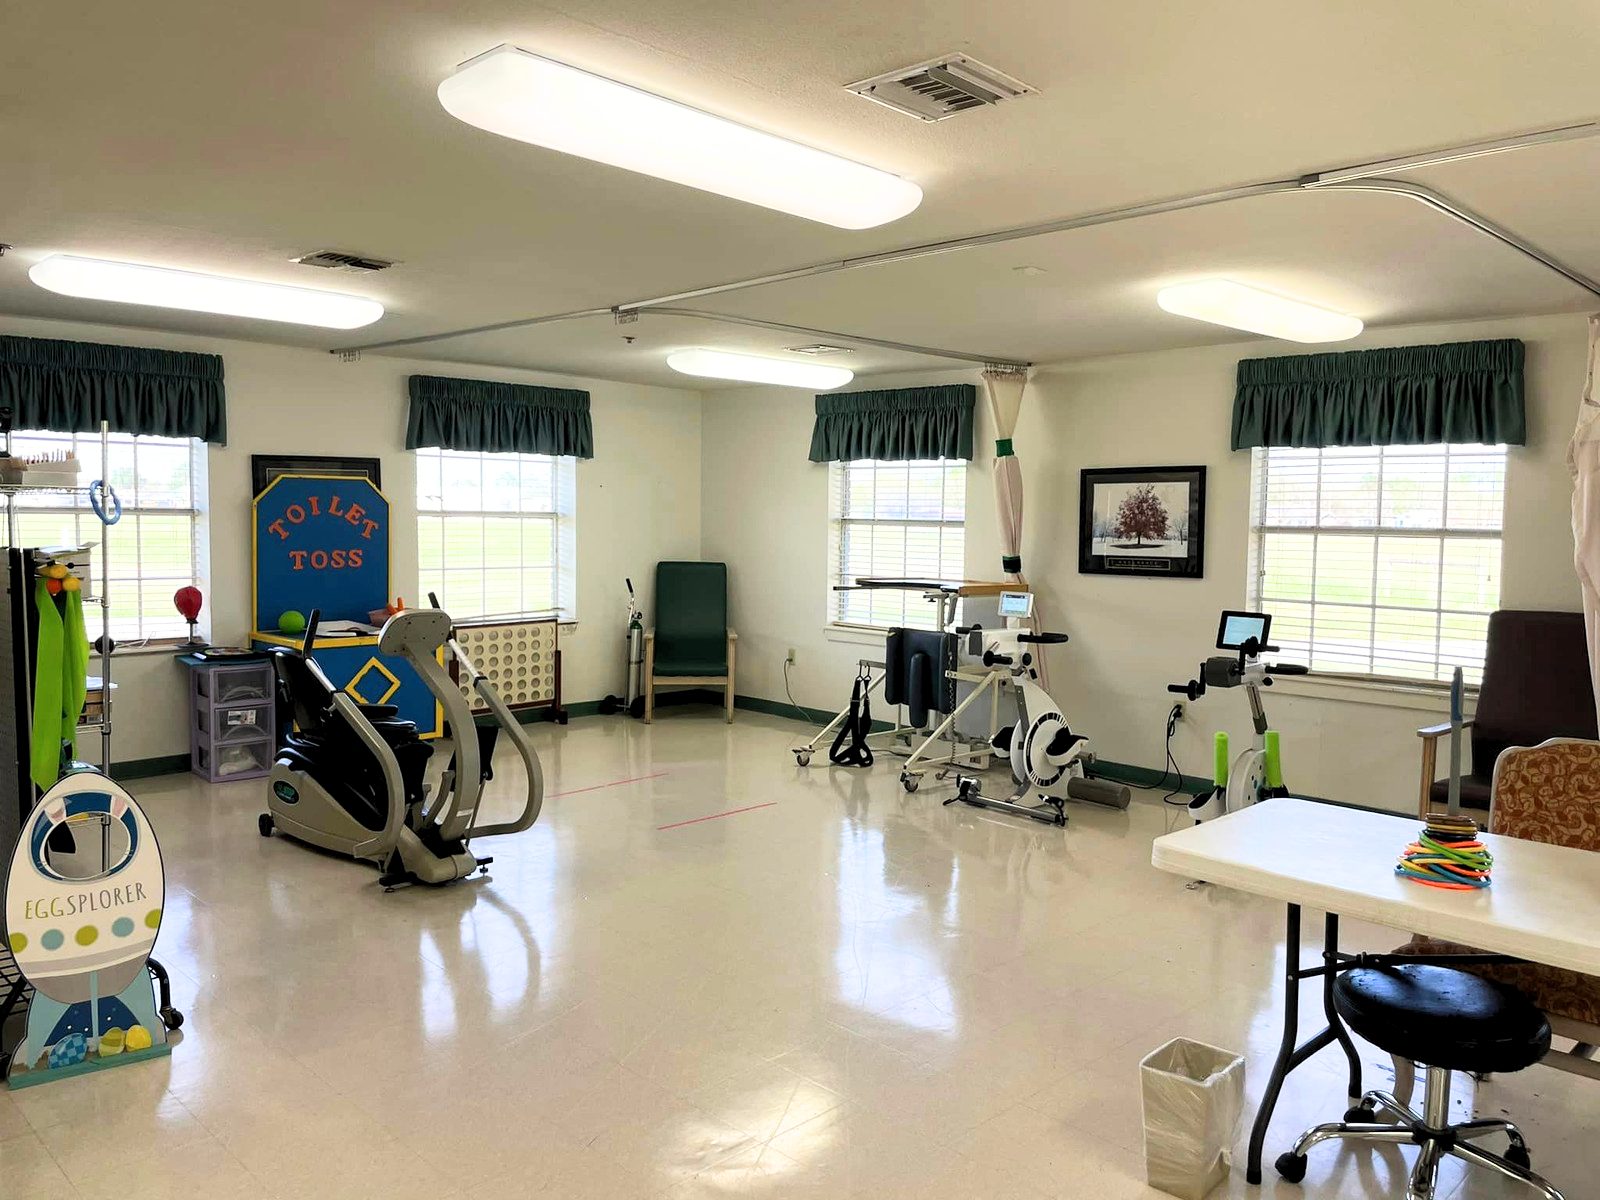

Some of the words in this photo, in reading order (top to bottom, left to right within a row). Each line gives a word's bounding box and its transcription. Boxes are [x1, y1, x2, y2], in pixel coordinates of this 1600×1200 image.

[268, 495, 379, 540] TOILET
[289, 549, 363, 570] TOSS
[25, 882, 147, 920] EGGSPLORER
